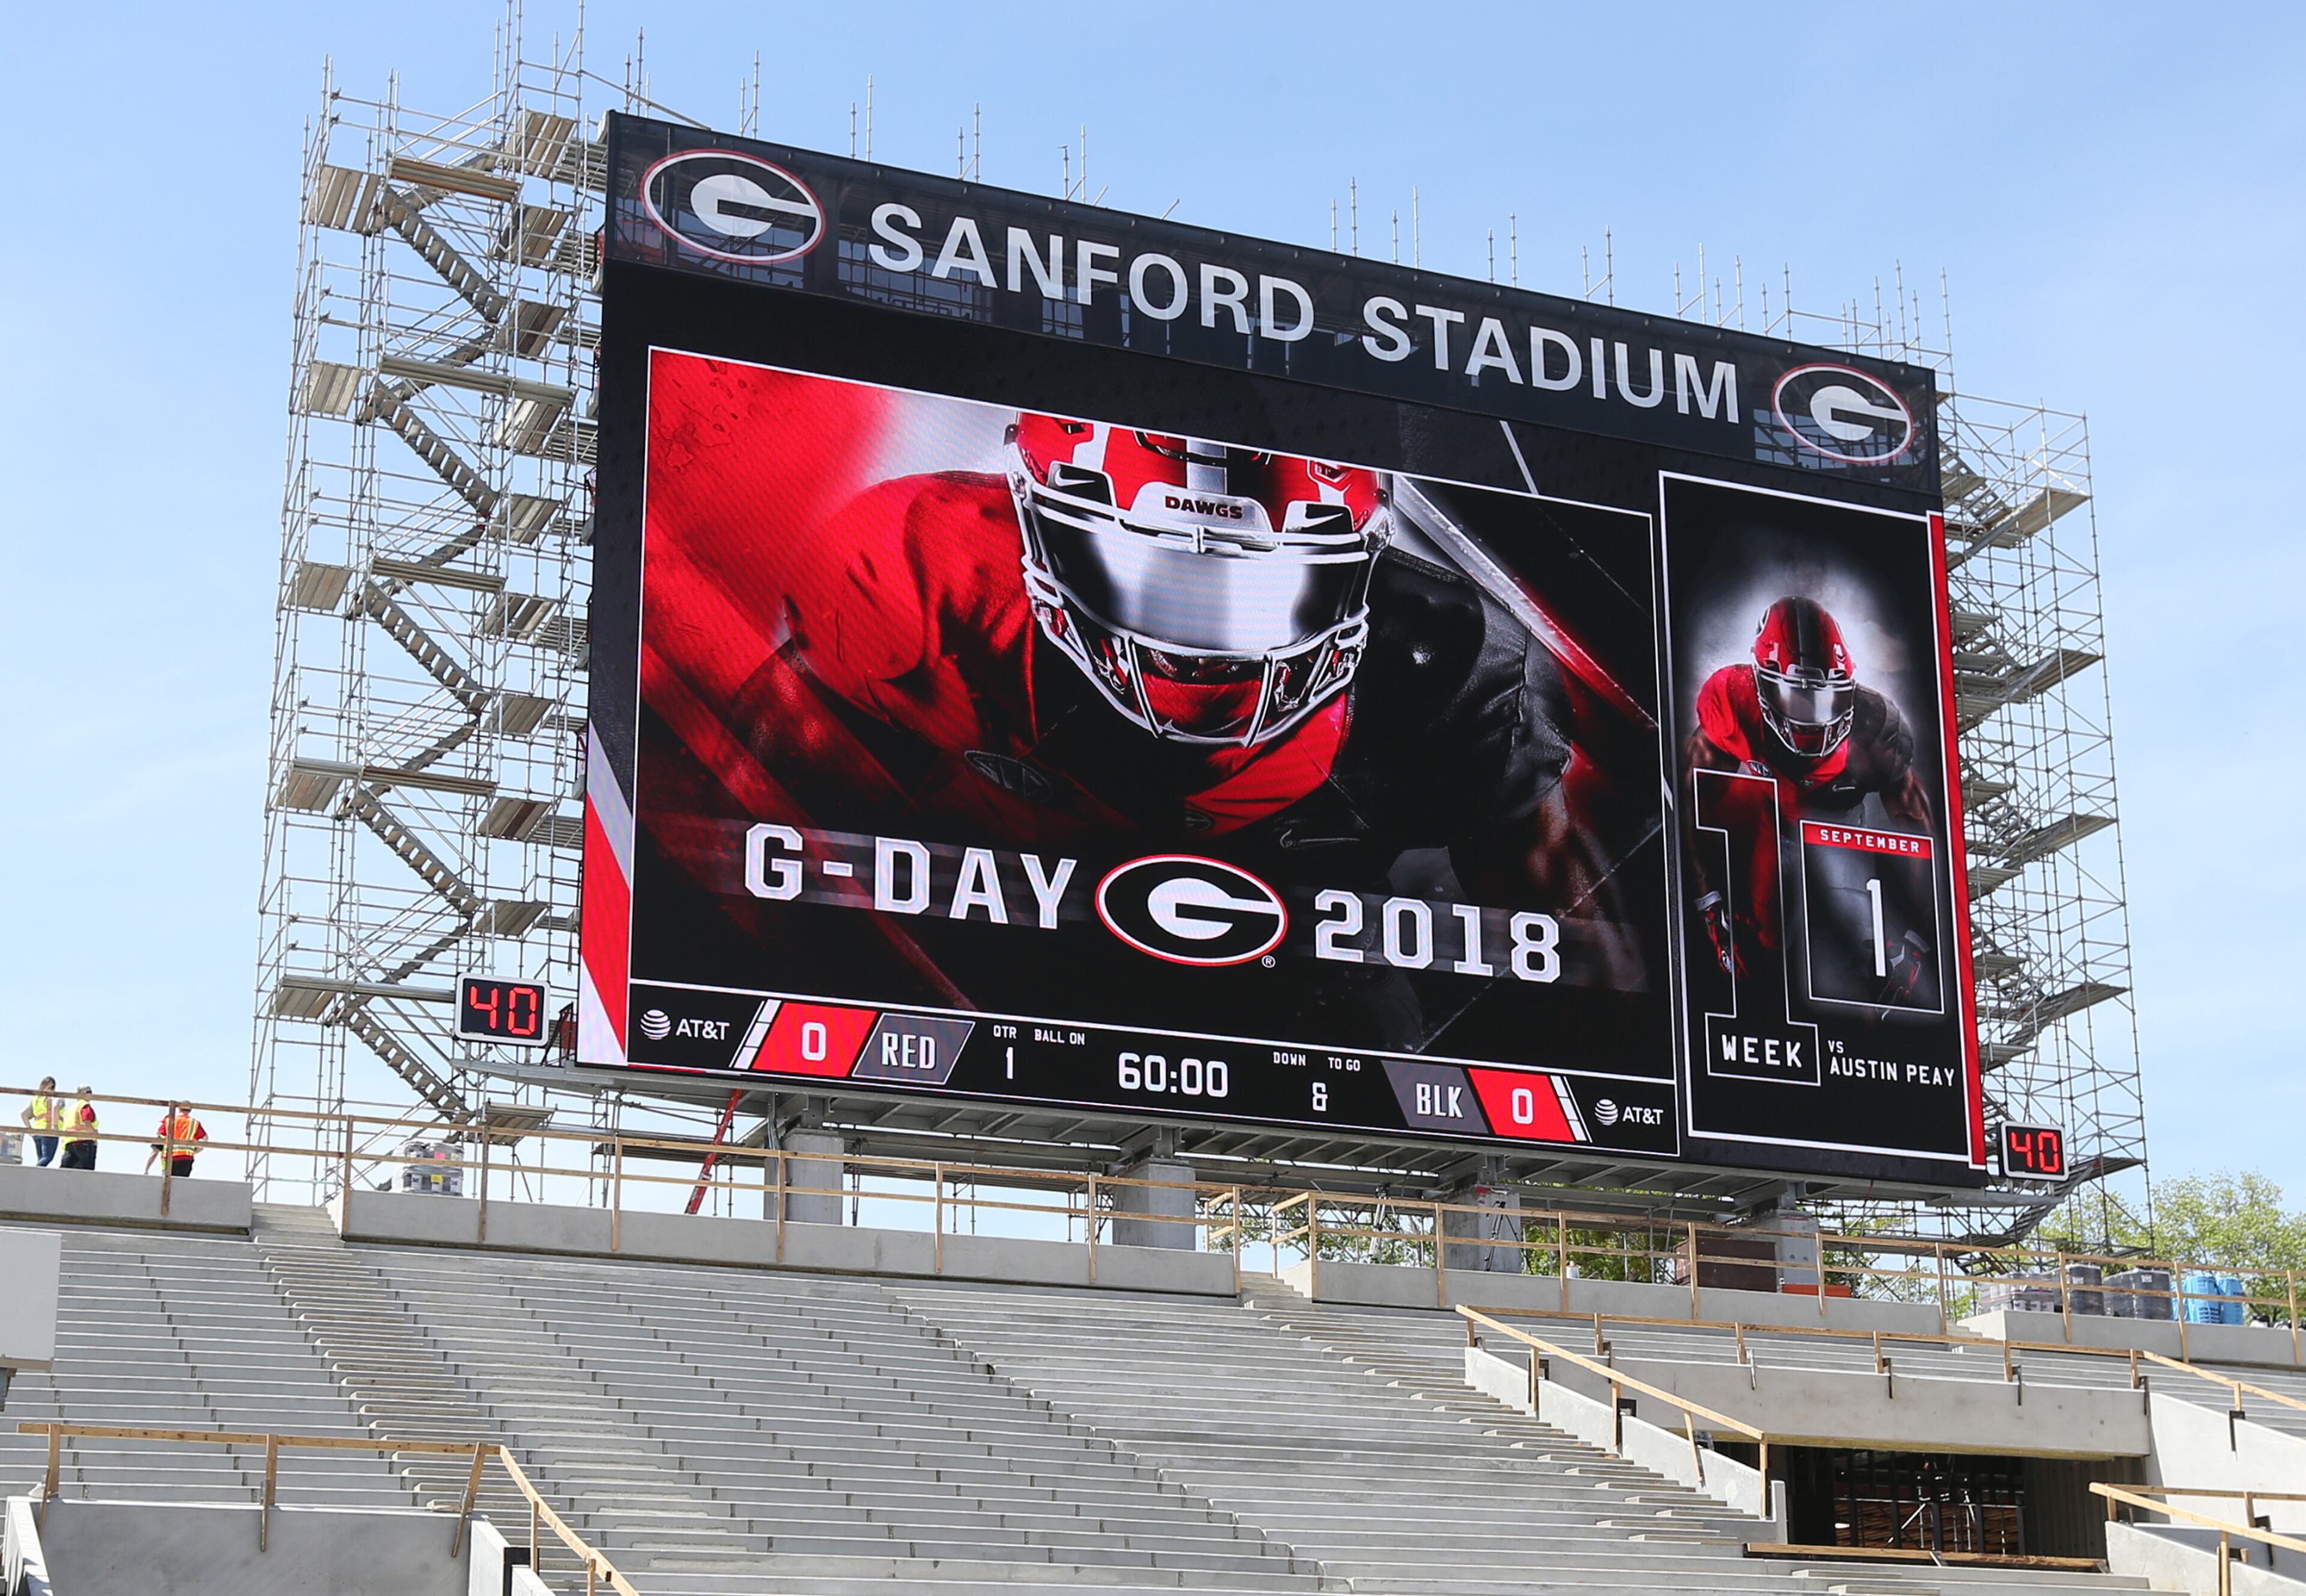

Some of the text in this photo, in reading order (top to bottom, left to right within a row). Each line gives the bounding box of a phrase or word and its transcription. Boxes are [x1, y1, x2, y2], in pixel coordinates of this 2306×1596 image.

[869, 203, 1739, 423] SANFORD STADIUM
[1165, 495, 1242, 519] DAWGS
[1820, 829, 1920, 853] SEPTEMBER
[745, 823, 1077, 929] G-DAY
[1315, 889, 1560, 983] 2018
[1867, 880, 1885, 976] 1
[470, 987, 537, 1035] 40
[676, 1019, 730, 1040] AT&T
[802, 1023, 826, 1060] 0
[994, 1025, 1016, 1039] QTR
[1035, 1029, 1085, 1045] BALL ON
[882, 1033, 934, 1068] RED
[1006, 1047, 1013, 1079] 1
[1274, 1052, 1306, 1066] DOWN
[1722, 1035, 1802, 1067] WEEK
[1828, 1041, 1844, 1053] VS
[1119, 1053, 1227, 1097] 60:00
[1328, 1057, 1360, 1071] TO GO
[1830, 1057, 1954, 1086] AUSTIN PEAY
[1313, 1082, 1328, 1111] &
[1417, 1084, 1462, 1117] BLK
[1512, 1089, 1533, 1124] 0
[1623, 1107, 1663, 1124] AT&T
[2011, 1132, 2059, 1172] 40
